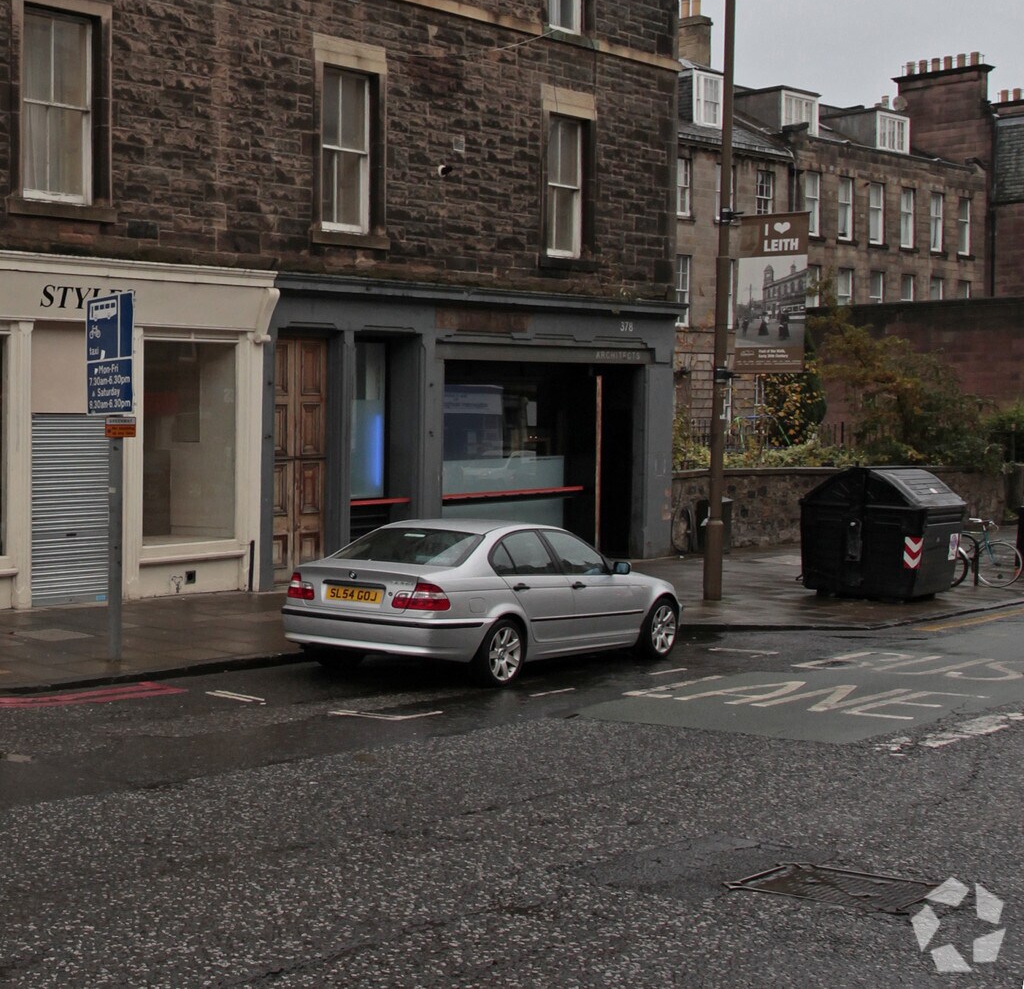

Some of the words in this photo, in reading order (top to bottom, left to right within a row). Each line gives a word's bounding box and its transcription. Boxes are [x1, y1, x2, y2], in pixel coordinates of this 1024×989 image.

[764, 223, 769, 236] I
[763, 237, 799, 252] LEITH
[39, 284, 136, 310] STY
[619, 321, 634, 332] 378
[89, 347, 100, 356] taxi
[98, 363, 119, 374] Mon-Fri
[97, 388, 120, 397] Saturday
[329, 588, 355, 599] SL54
[356, 590, 378, 602] GOJ
[791, 651, 1024, 681] BUS
[622, 675, 990, 720] LANE
